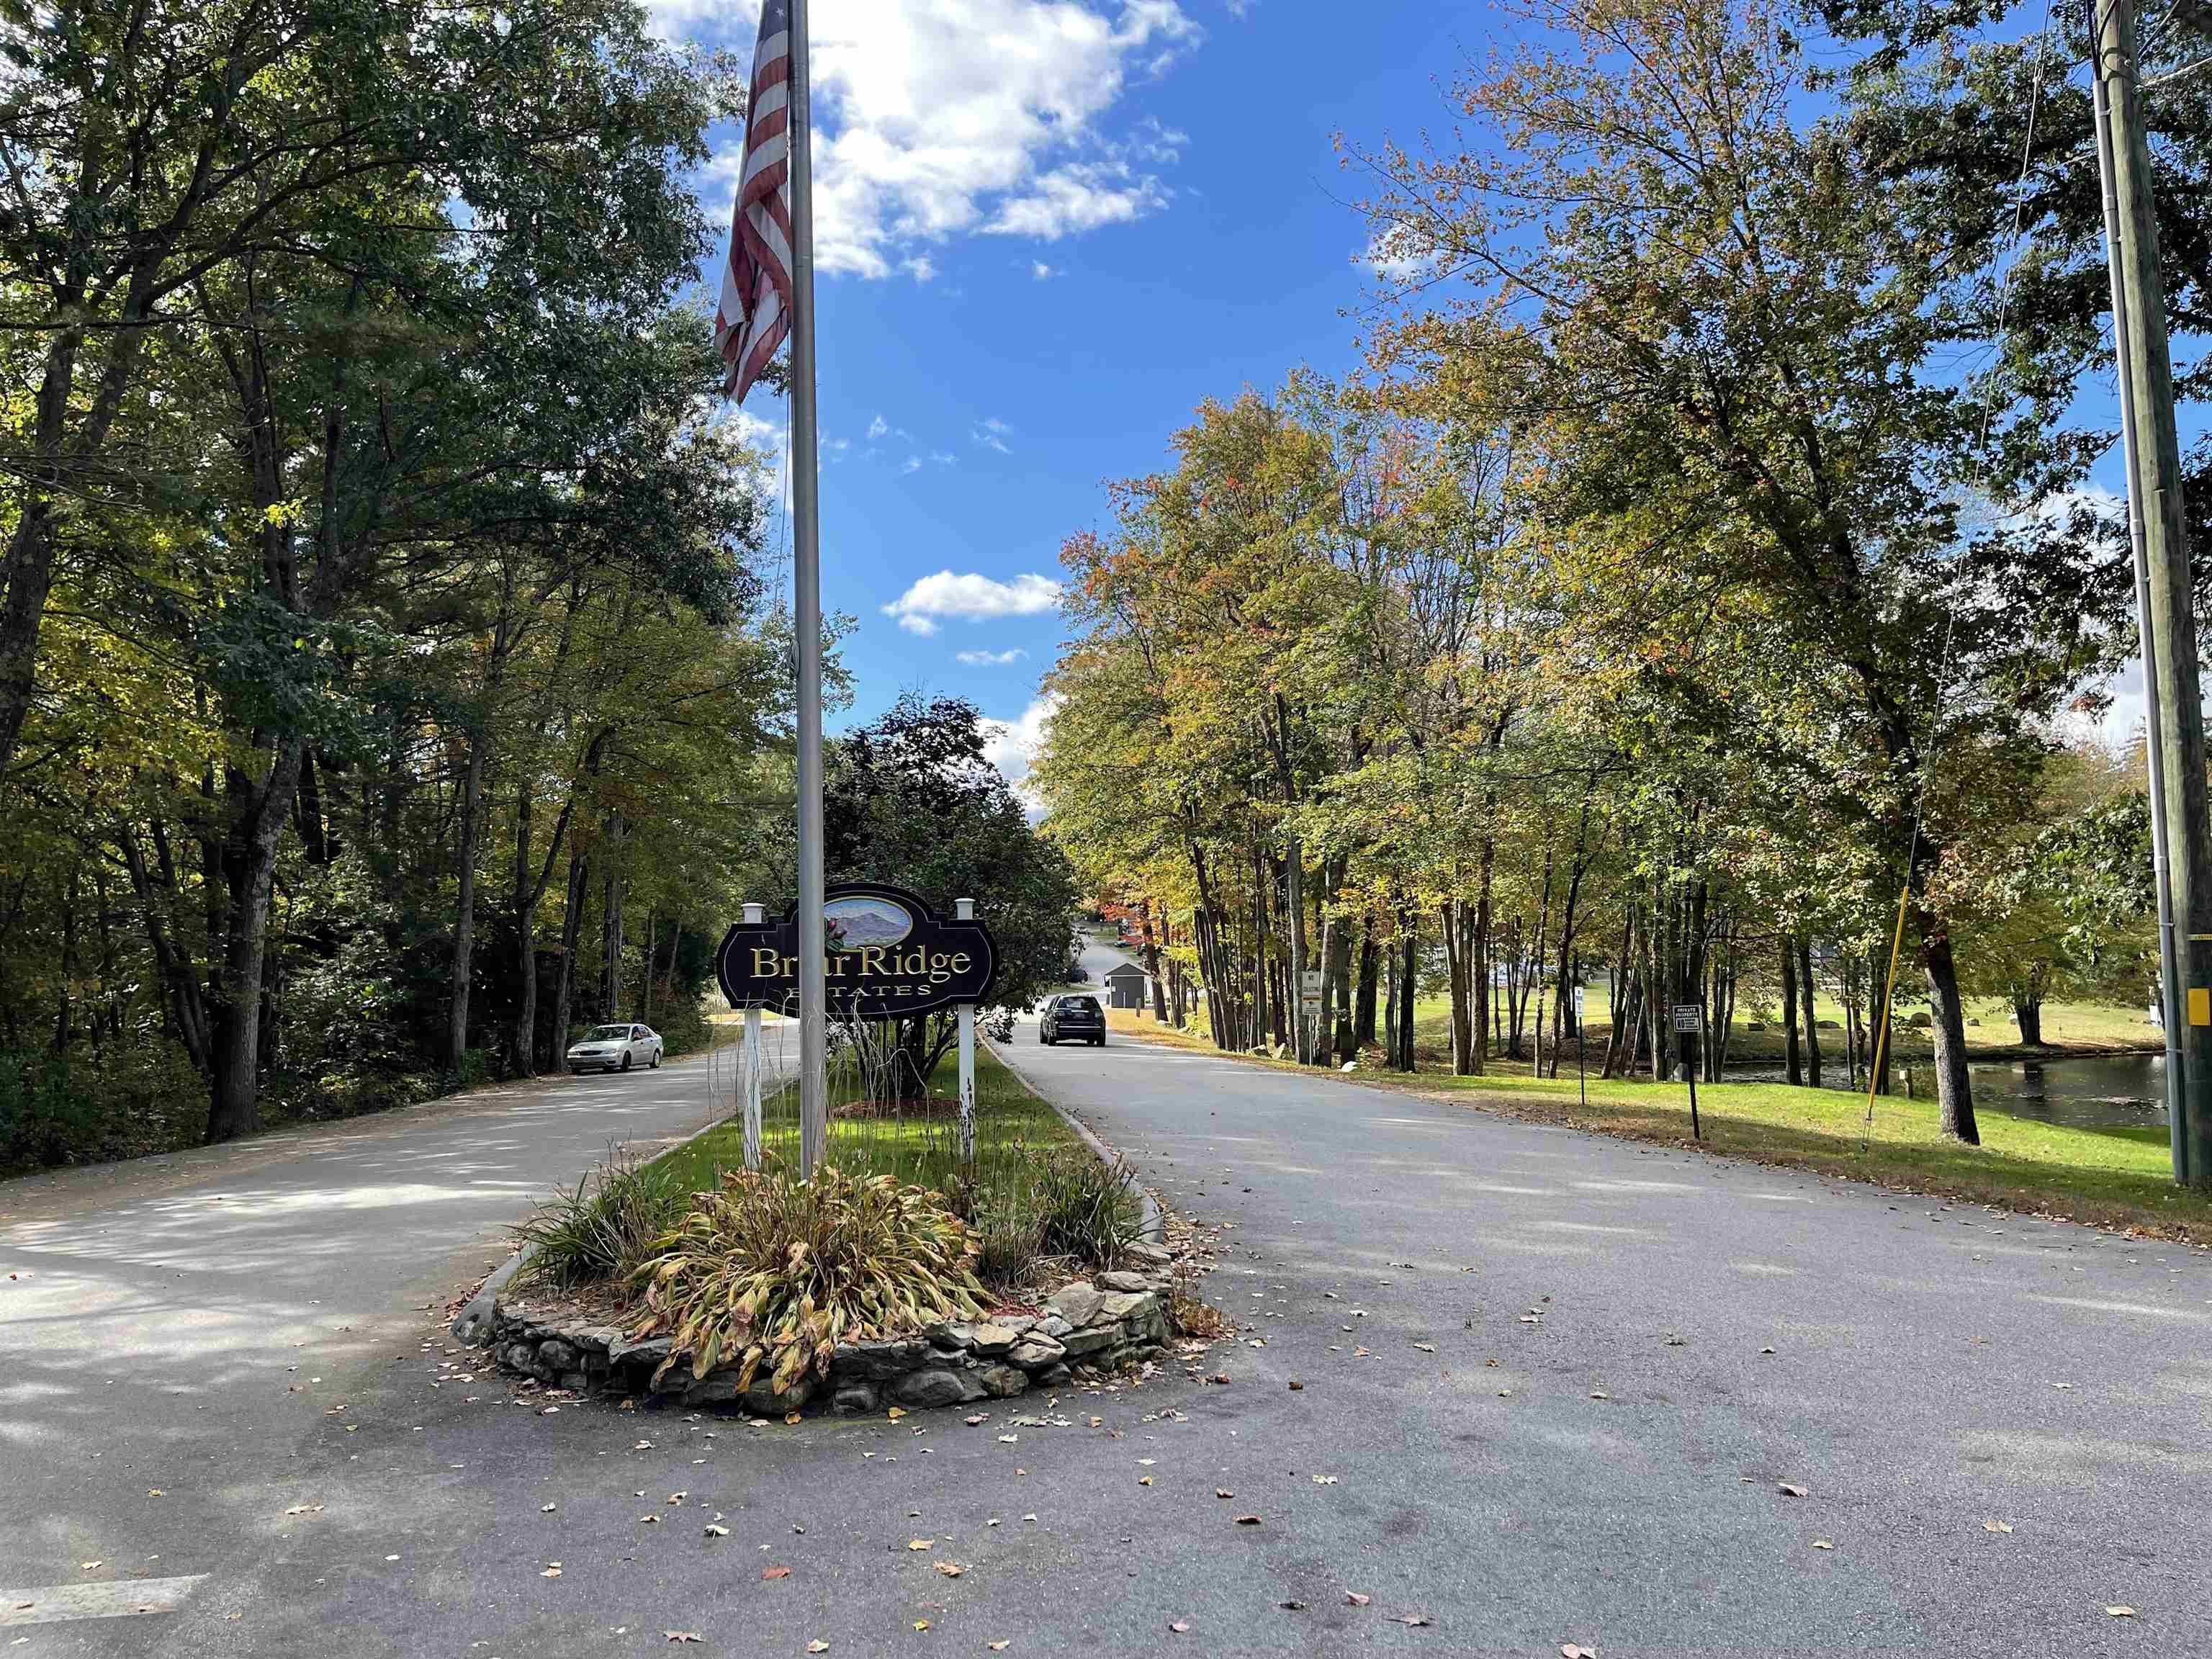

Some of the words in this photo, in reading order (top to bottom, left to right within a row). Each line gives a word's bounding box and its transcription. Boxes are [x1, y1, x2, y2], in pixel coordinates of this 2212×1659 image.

[750, 948, 850, 977] Brr
[858, 944, 972, 984] Ridge
[786, 985, 932, 997] ETATES
